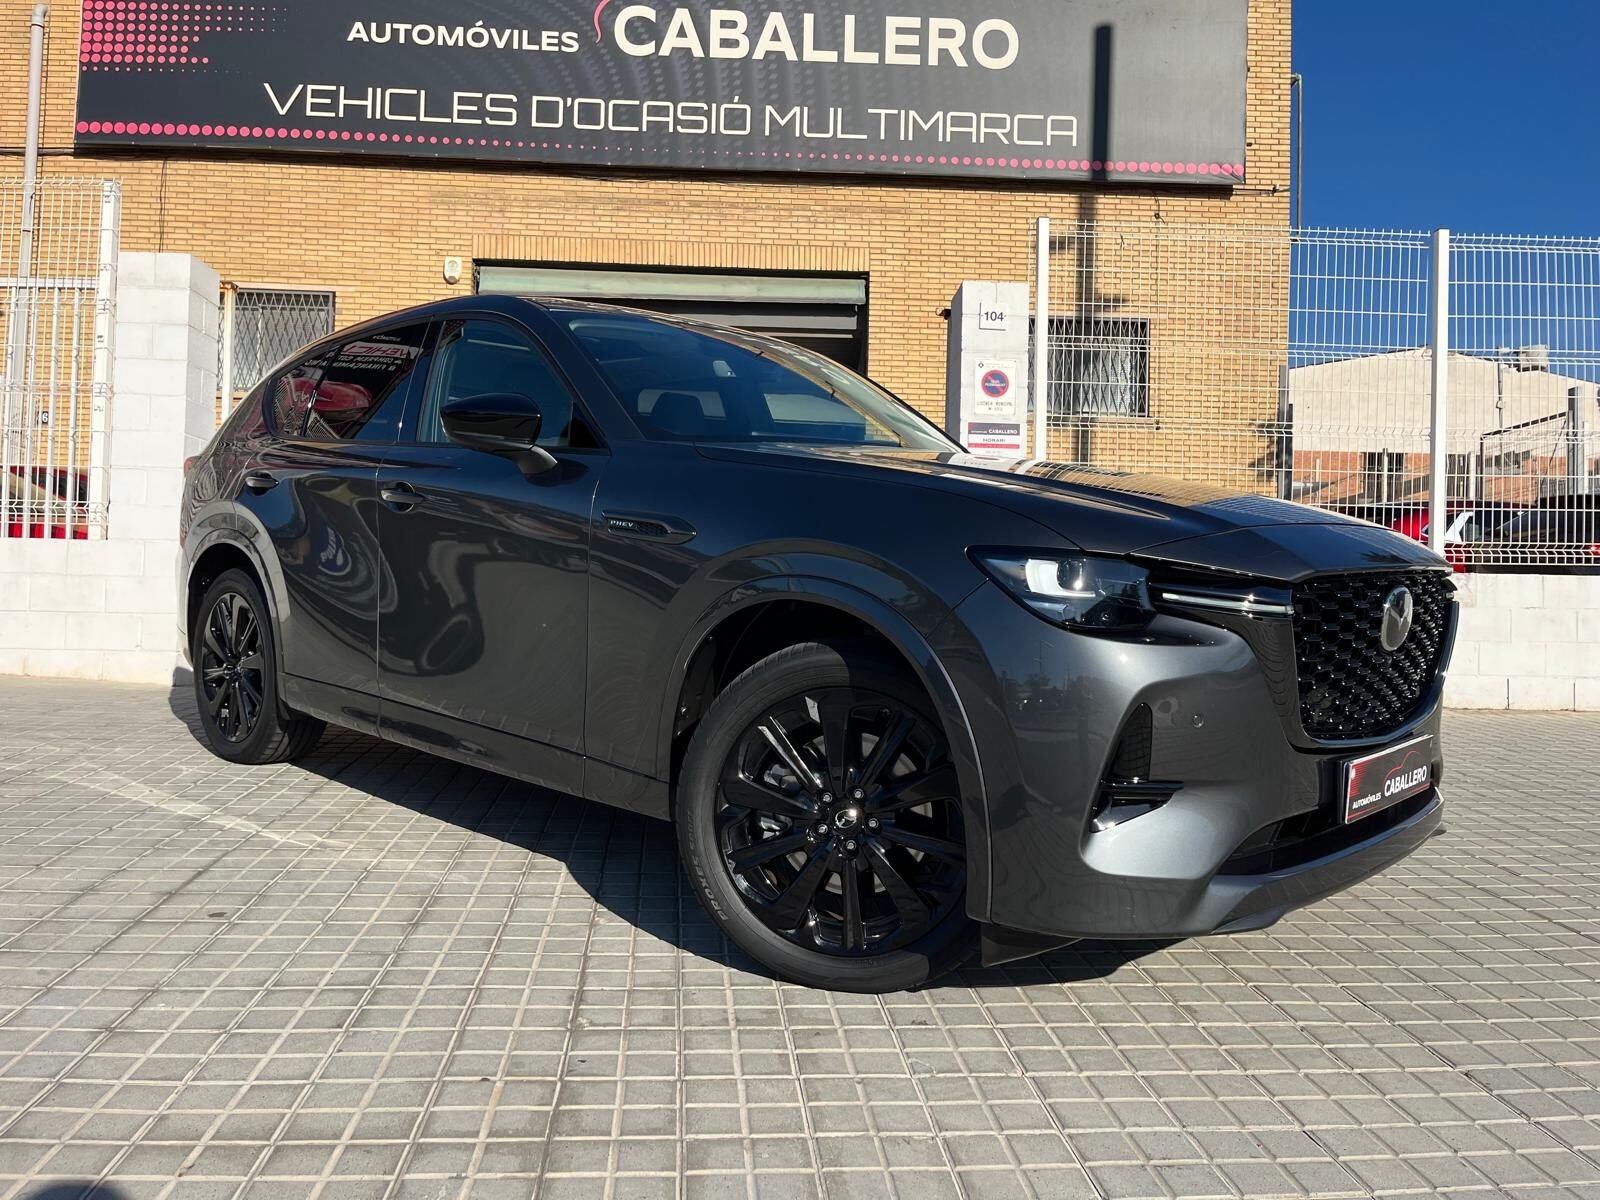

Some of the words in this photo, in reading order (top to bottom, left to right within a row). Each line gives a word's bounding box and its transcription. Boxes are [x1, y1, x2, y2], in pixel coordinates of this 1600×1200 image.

[347, 20, 580, 53] AUTOMÓVILES
[613, 6, 1020, 71] CABALLERO
[263, 82, 517, 127] VEHICLES
[531, 94, 752, 137] D'OCASIÓ
[984, 311, 1005, 322] 104
[610, 520, 634, 528] PHEV
[1352, 792, 1382, 809] AUTOMÓVILES
[1384, 765, 1428, 797] CABALLERO
[692, 855, 729, 921] PROXES
